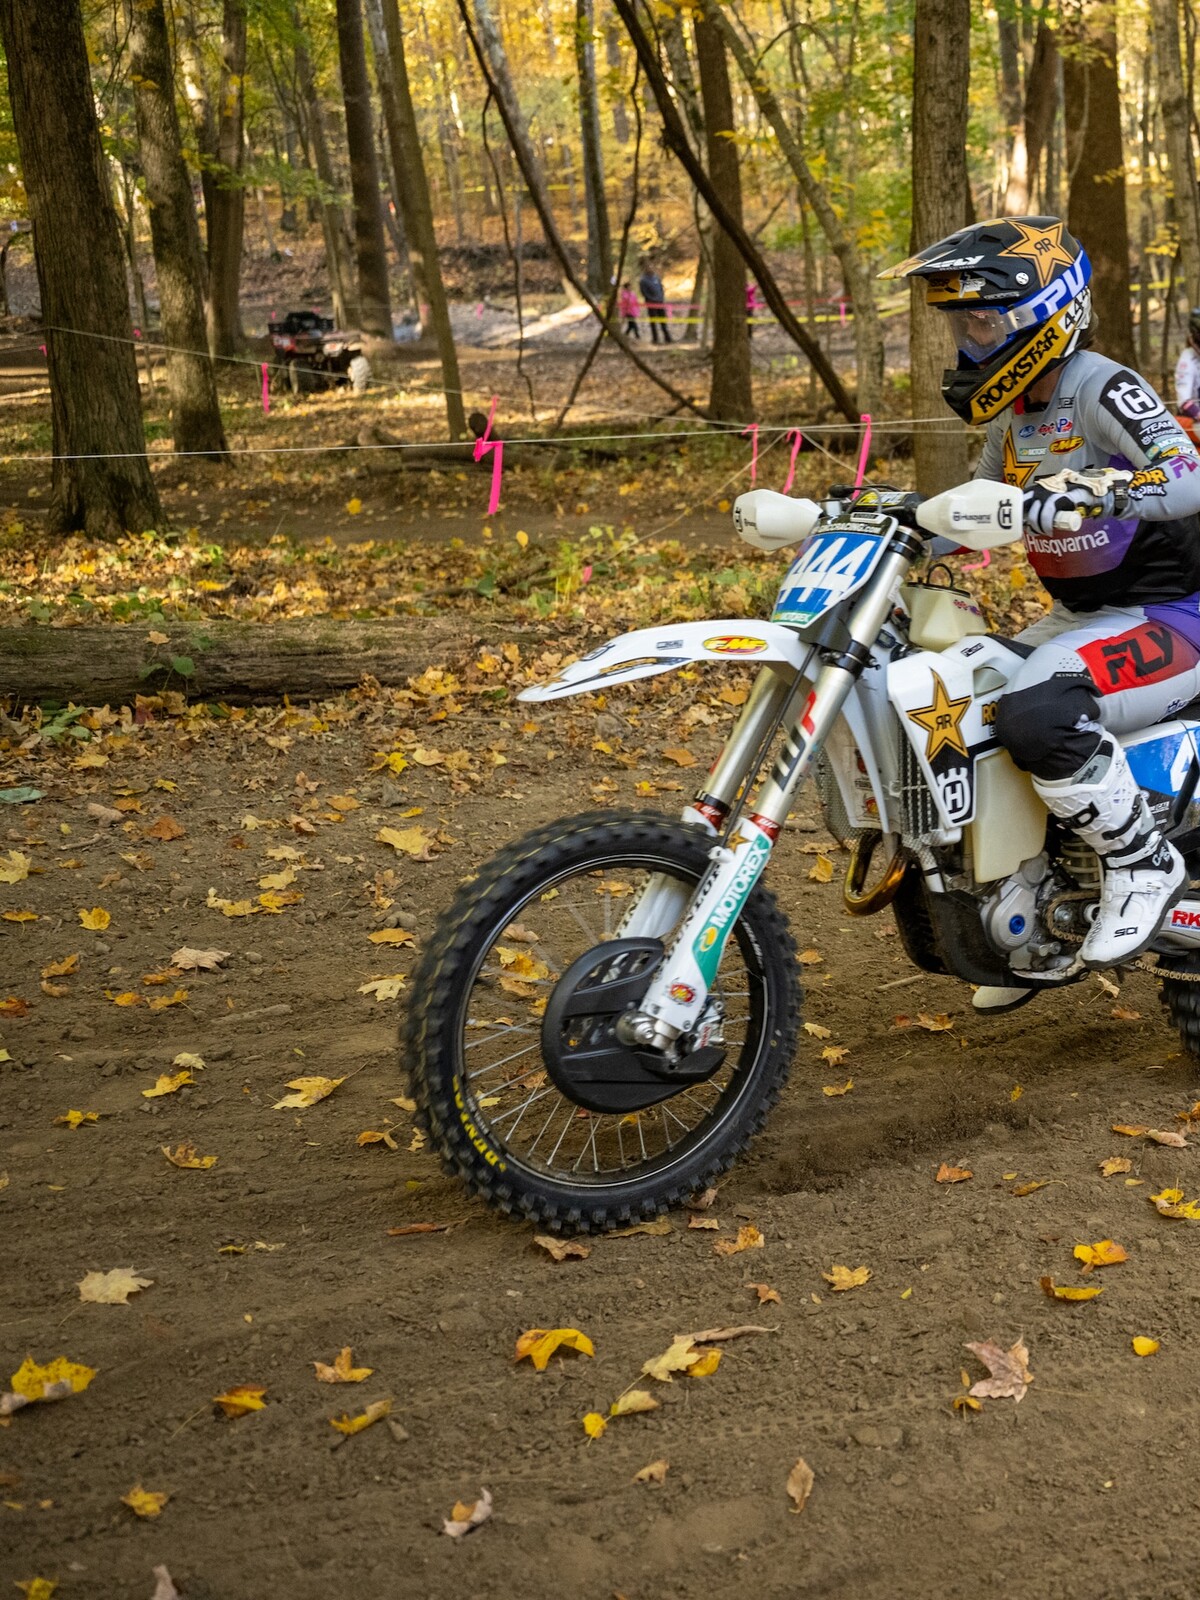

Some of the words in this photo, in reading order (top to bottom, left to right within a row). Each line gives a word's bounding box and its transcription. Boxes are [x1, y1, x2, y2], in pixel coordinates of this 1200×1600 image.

[977, 326, 1059, 415] ROCKSTAR
[1052, 437, 1083, 451] FMF
[1146, 419, 1174, 434] TEAM
[1027, 529, 1110, 557] Husqvarna
[778, 537, 877, 606] 444
[703, 638, 767, 650] FMF
[1101, 626, 1174, 685] FLY
[709, 845, 768, 929] MOTOREX
